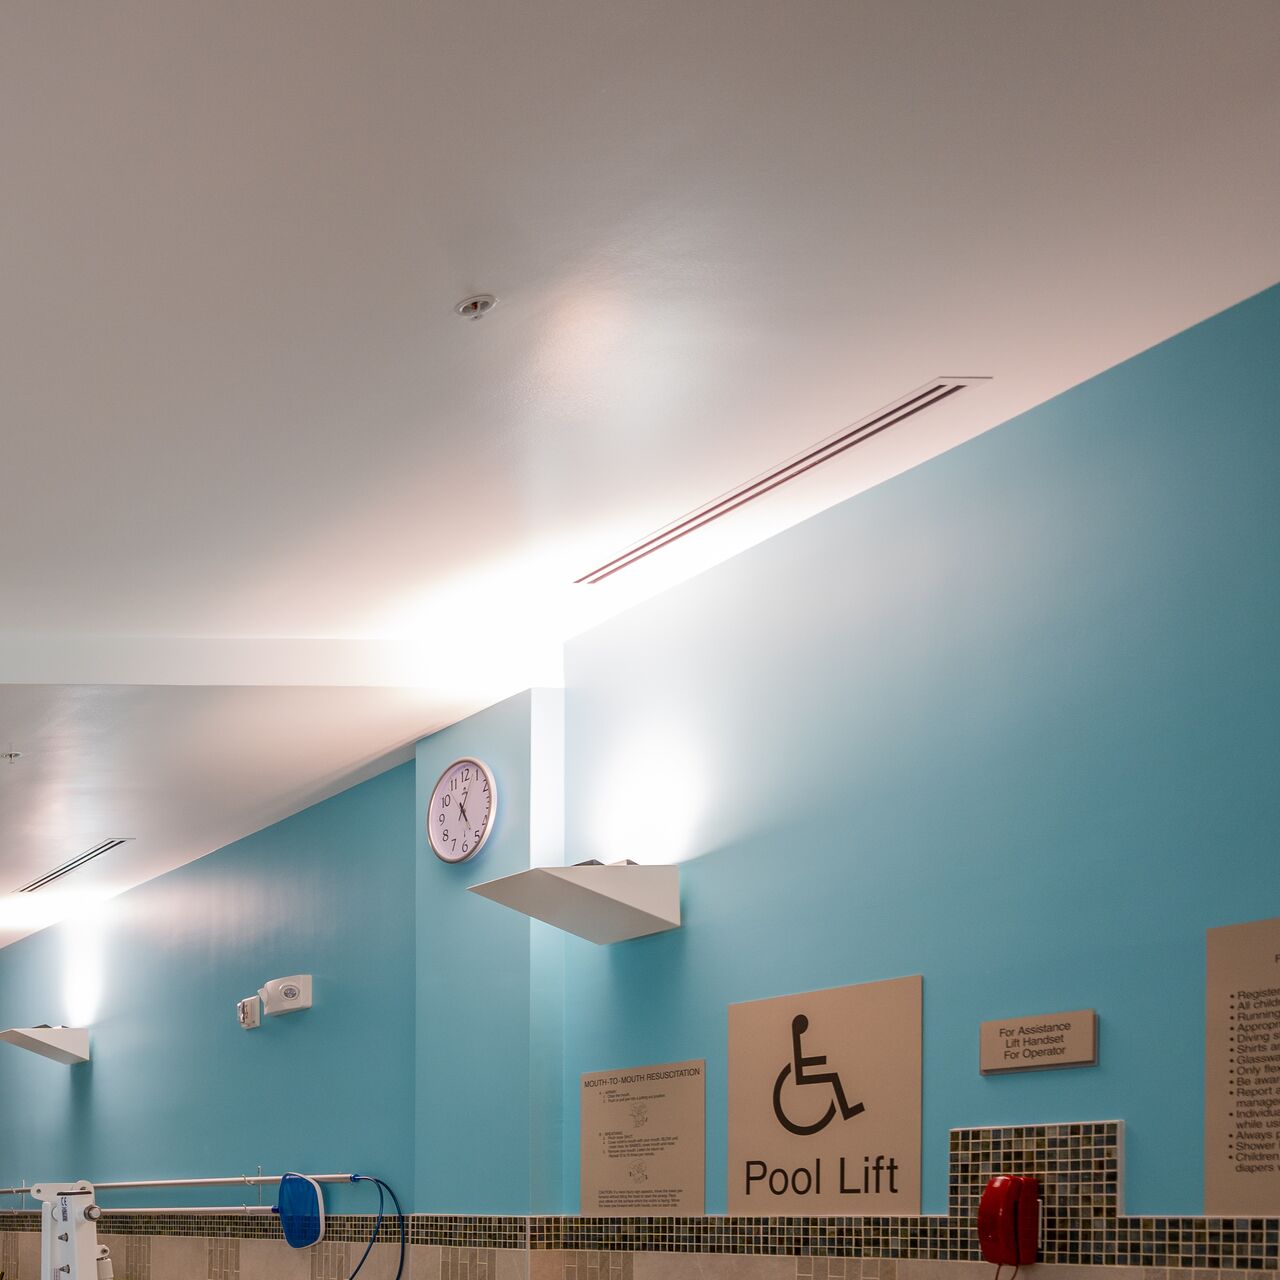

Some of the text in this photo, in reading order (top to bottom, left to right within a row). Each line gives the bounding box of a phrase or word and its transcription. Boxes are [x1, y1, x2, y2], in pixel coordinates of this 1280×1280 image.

[461, 768, 470, 782] 12
[475, 769, 479, 780] 1
[450, 778, 457, 791] 11
[482, 779, 489, 792] 2
[442, 794, 451, 808] 10
[439, 813, 445, 826] 9
[442, 829, 449, 842] 8
[451, 838, 457, 852] 7
[461, 840, 468, 853] 6
[1237, 1001, 1251, 1010] All
[1237, 1011, 1280, 1022] Running
[999, 1022, 1071, 1038] For Assistance
[1005, 1034, 1064, 1048] Lift Handset
[1236, 1033, 1270, 1043] Diving
[1003, 1046, 1066, 1060] For Operator
[1237, 1044, 1268, 1054] Shirts
[1236, 1065, 1261, 1076] Only
[584, 1067, 701, 1088] MOUTH-TO-MOUTH RESUSCITATION
[1236, 1077, 1251, 1086] Be
[1236, 1087, 1272, 1099] Report
[1235, 1120, 1263, 1129] while
[1235, 1131, 1273, 1141] Always
[1235, 1141, 1275, 1151] Shower
[1235, 1152, 1279, 1162] Children
[1235, 1163, 1274, 1174] diapers
[745, 1155, 899, 1196] Pool Lift
